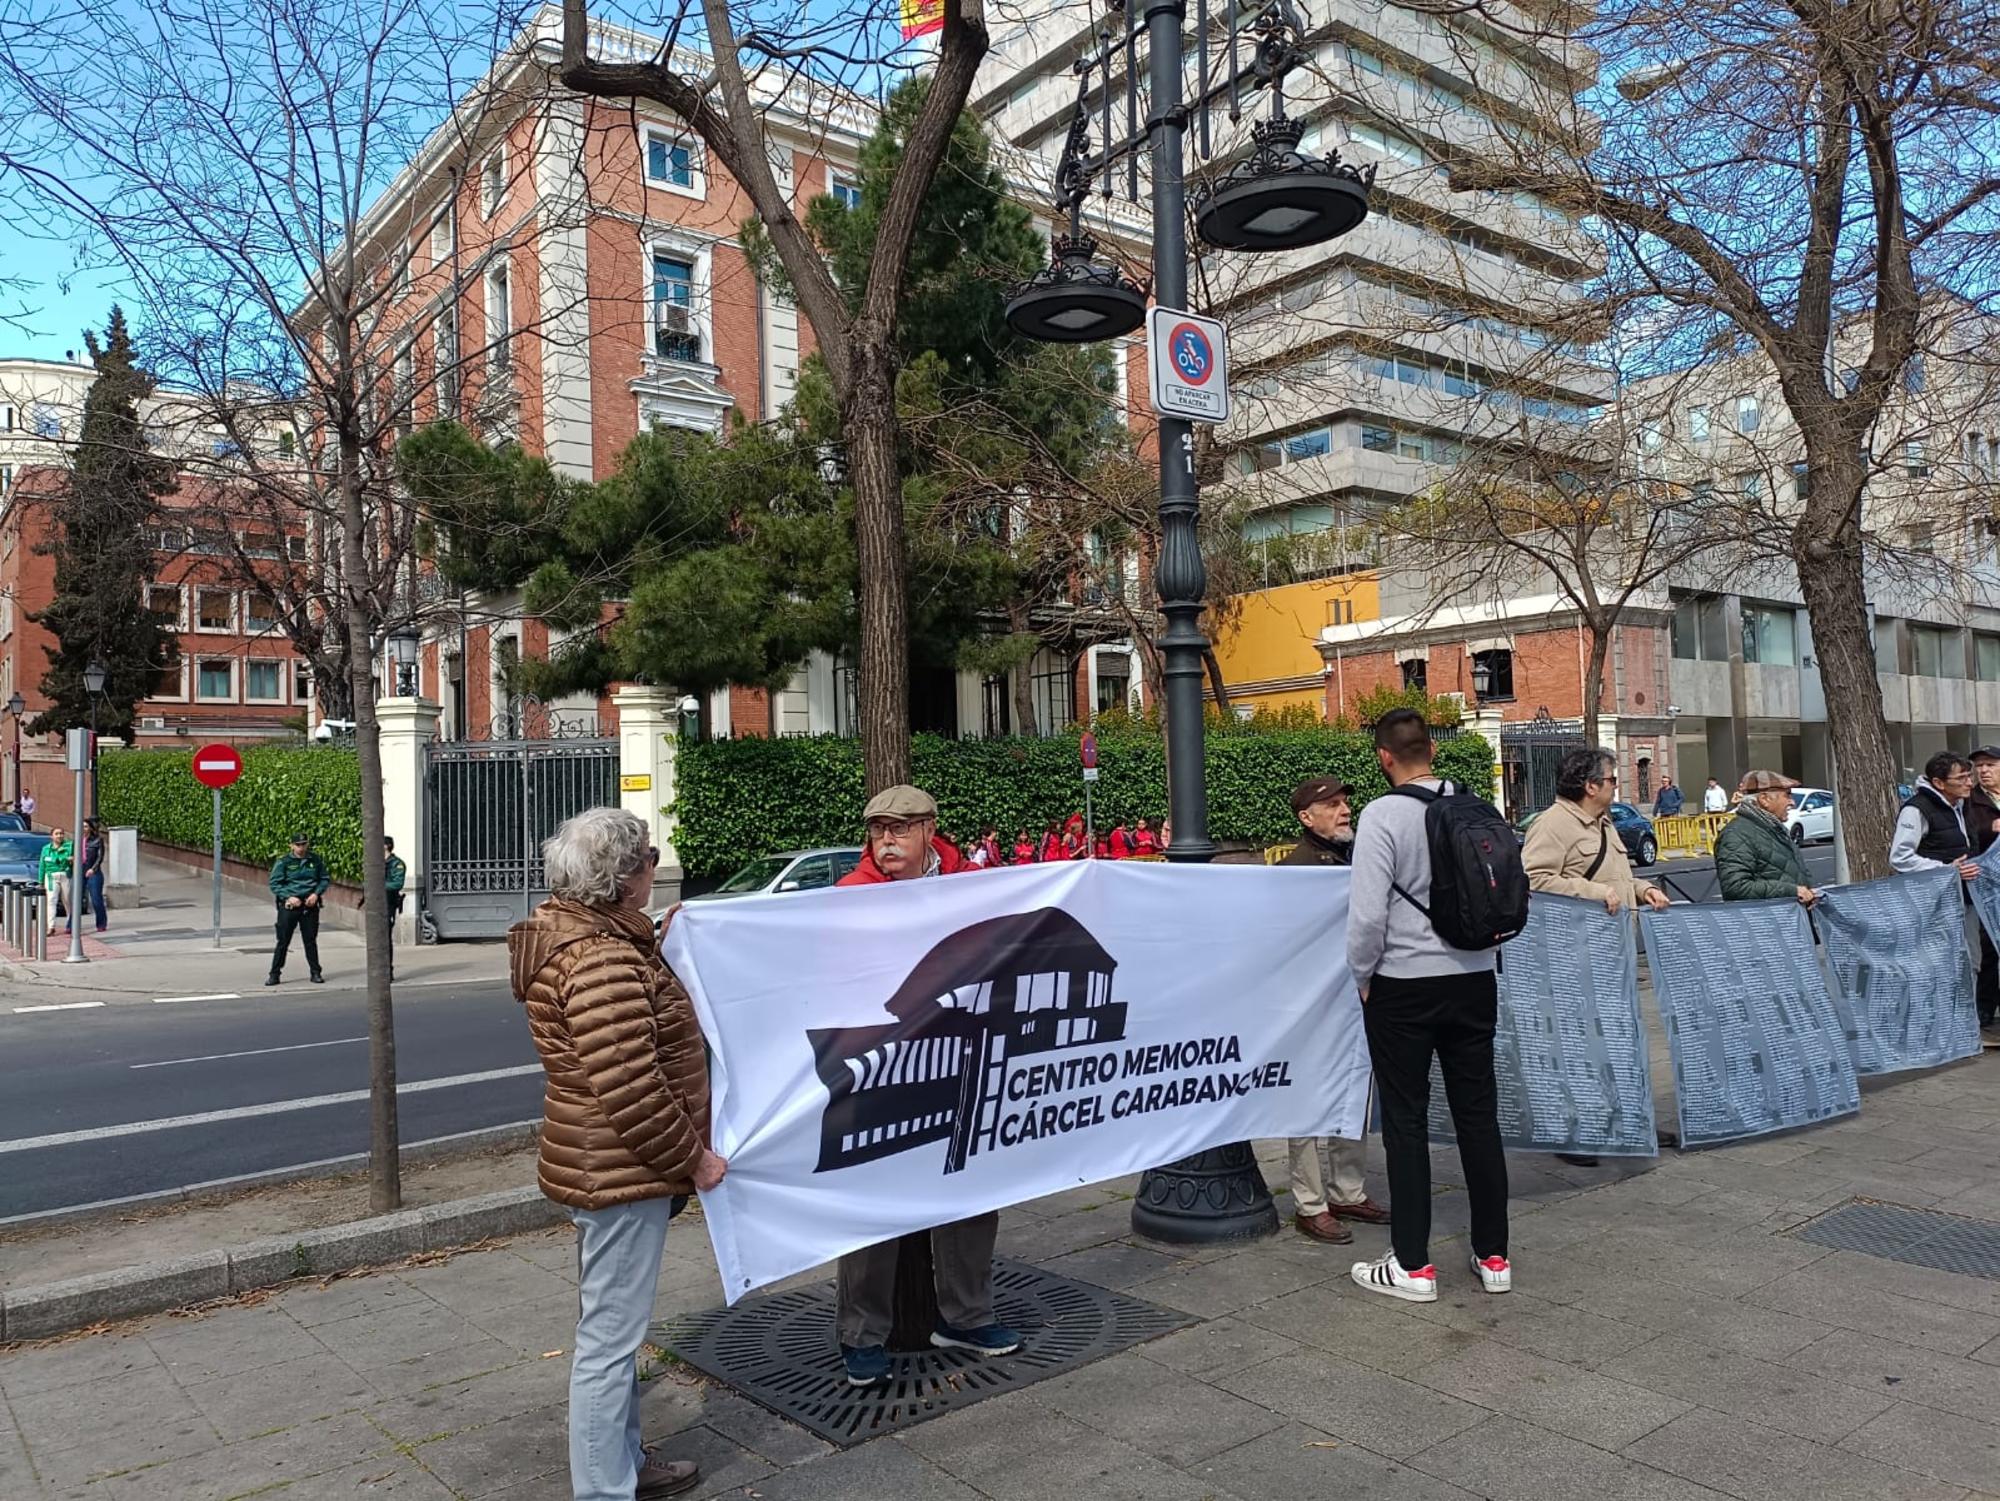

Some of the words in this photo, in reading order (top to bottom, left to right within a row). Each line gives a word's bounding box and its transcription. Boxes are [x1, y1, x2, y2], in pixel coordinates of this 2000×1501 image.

[1007, 1053, 1117, 1101] CENTRO
[1121, 1035, 1241, 1079] MEMORIA
[1000, 1097, 1105, 1147] CÁRCEL
